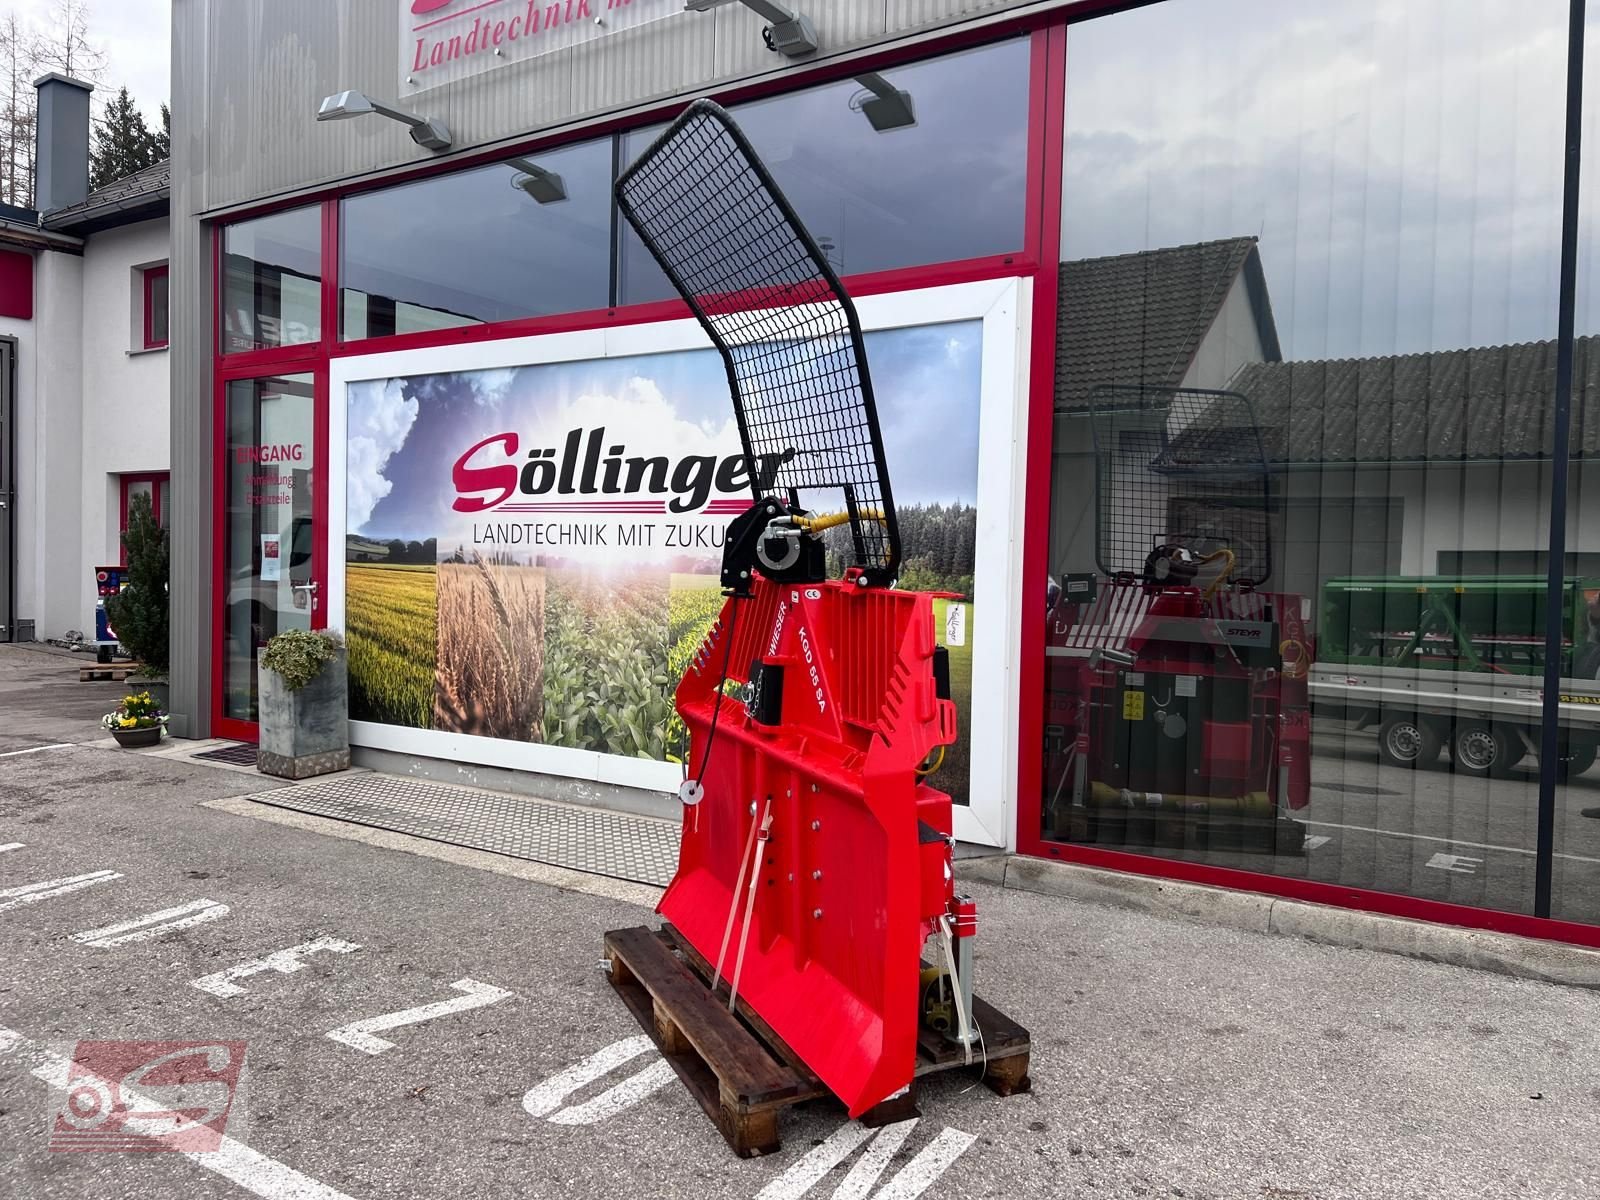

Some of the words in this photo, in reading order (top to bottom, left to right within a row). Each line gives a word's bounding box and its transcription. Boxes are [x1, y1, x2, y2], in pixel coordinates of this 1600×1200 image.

[236, 443, 302, 464] EINGANG
[452, 426, 796, 514] Söllinger
[473, 523, 608, 546] LANDTECHNIK
[617, 524, 656, 547] MIT
[664, 524, 726, 548] ZUKU
[768, 600, 787, 656] WIESER
[1226, 628, 1262, 637] STEYR
[799, 626, 813, 664] KGD
[816, 687, 826, 713] SA
